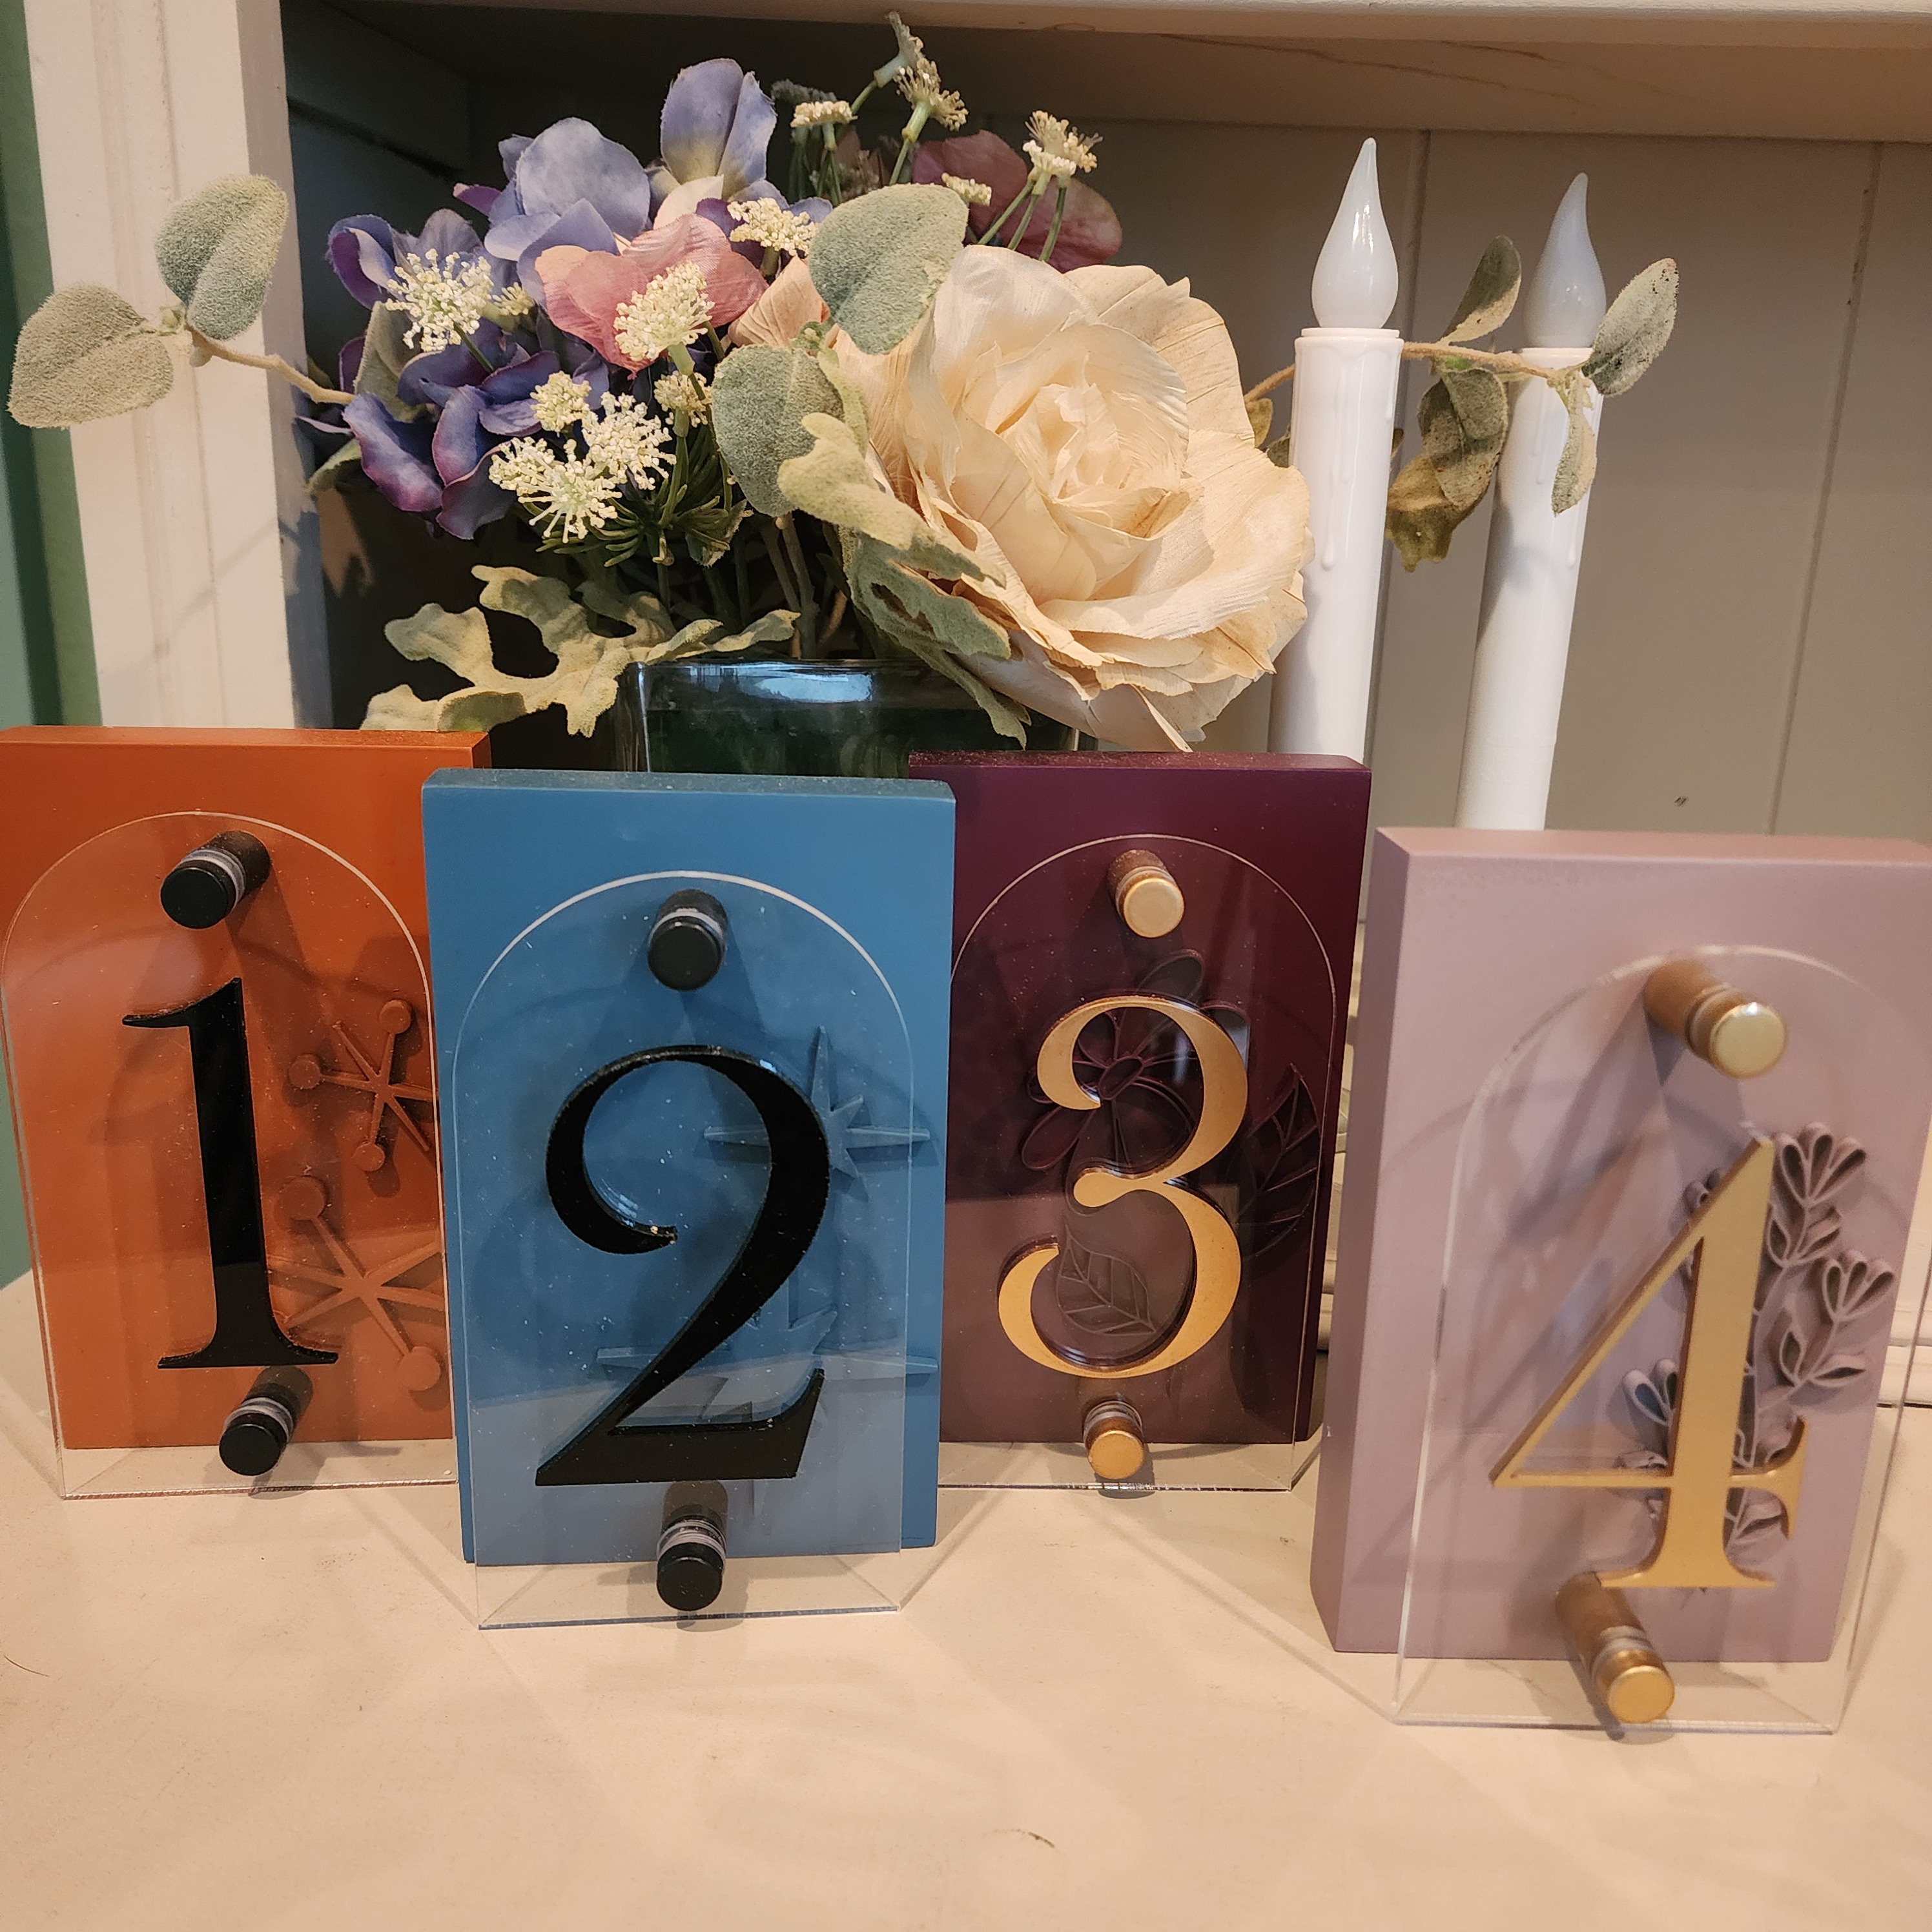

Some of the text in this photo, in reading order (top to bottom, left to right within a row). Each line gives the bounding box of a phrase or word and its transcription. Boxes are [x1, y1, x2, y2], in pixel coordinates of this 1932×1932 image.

[122, 978, 338, 1368] 1
[535, 1046, 827, 1486] 2
[998, 995, 1248, 1377] 3
[1488, 1136, 1807, 1589] 4
